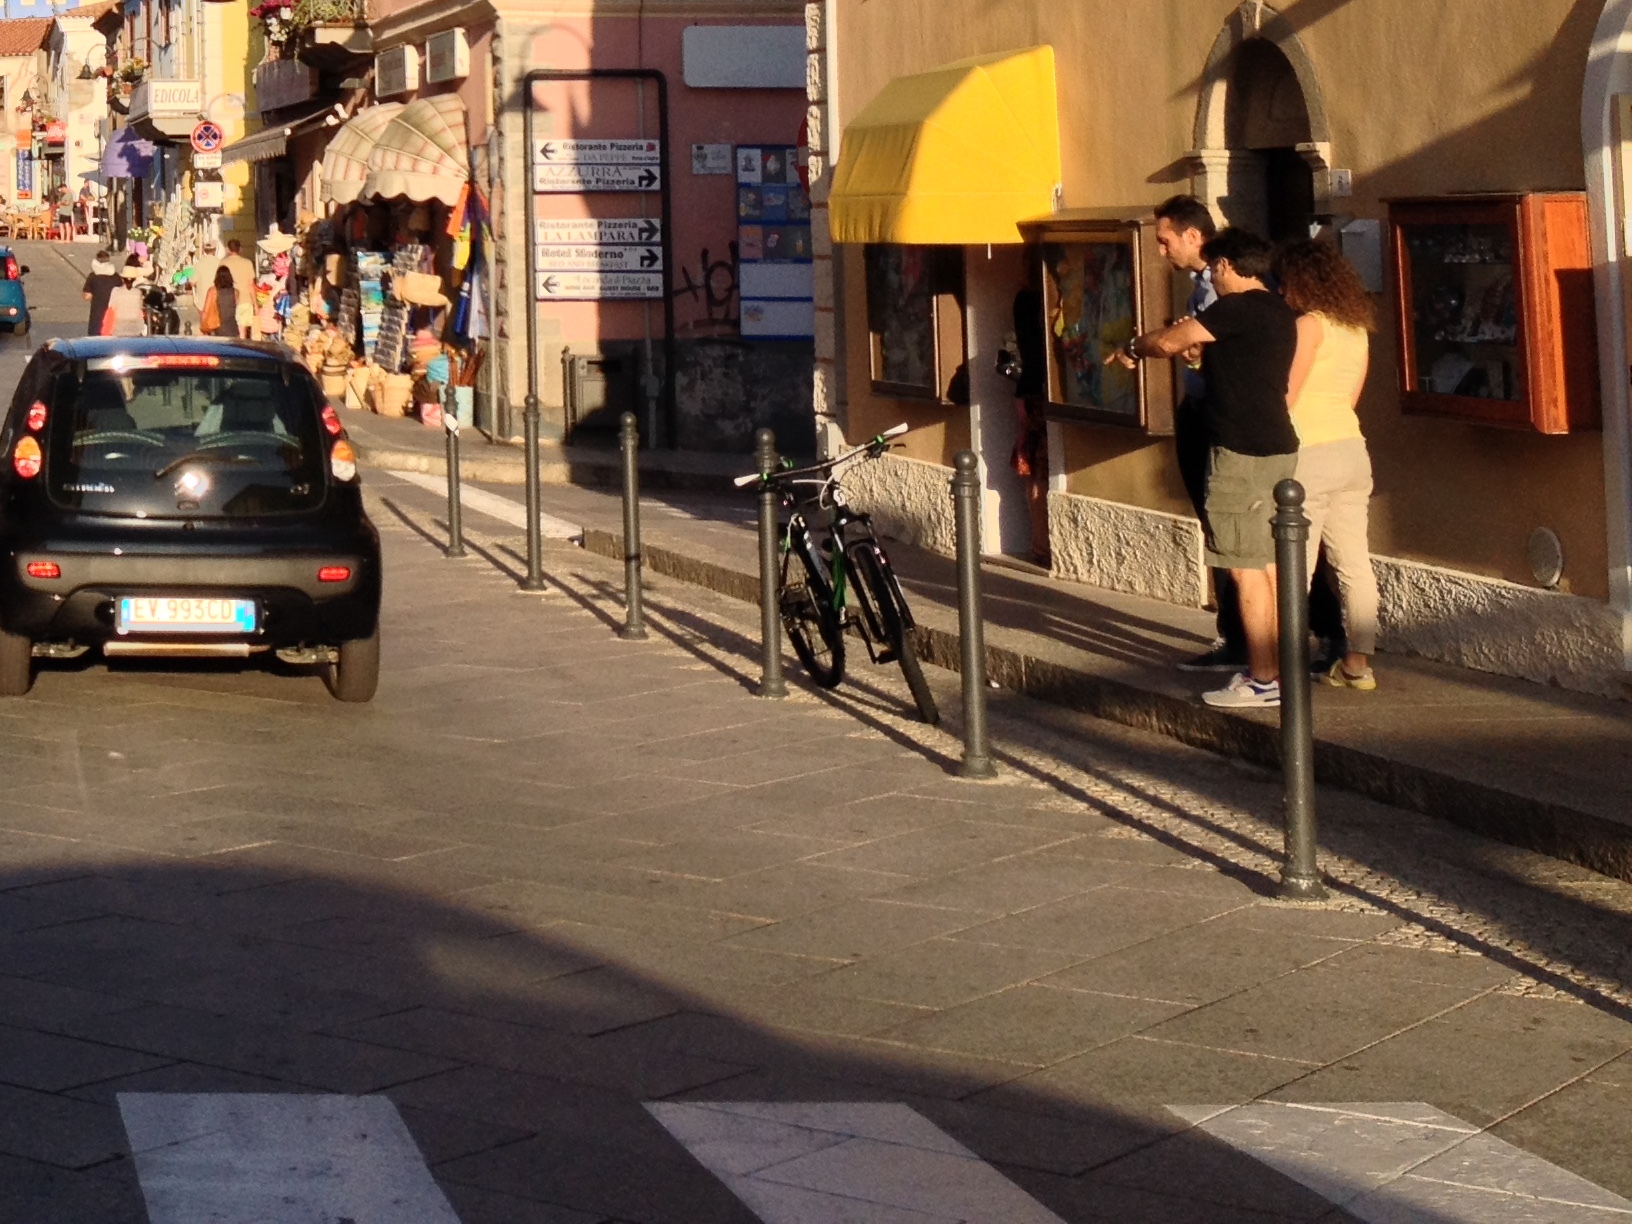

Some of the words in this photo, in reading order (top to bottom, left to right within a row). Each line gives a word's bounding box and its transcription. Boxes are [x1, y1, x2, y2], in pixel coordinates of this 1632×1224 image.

[153, 88, 199, 104] EDICOLA
[610, 142, 644, 152] Pizzeria
[546, 166, 623, 178] AZZURRA
[595, 177, 636, 186] Pizzeria
[539, 221, 595, 230] Ristorante
[597, 220, 638, 229] Pizzeria
[541, 248, 572, 258] Hotel
[575, 249, 624, 259] Moderno
